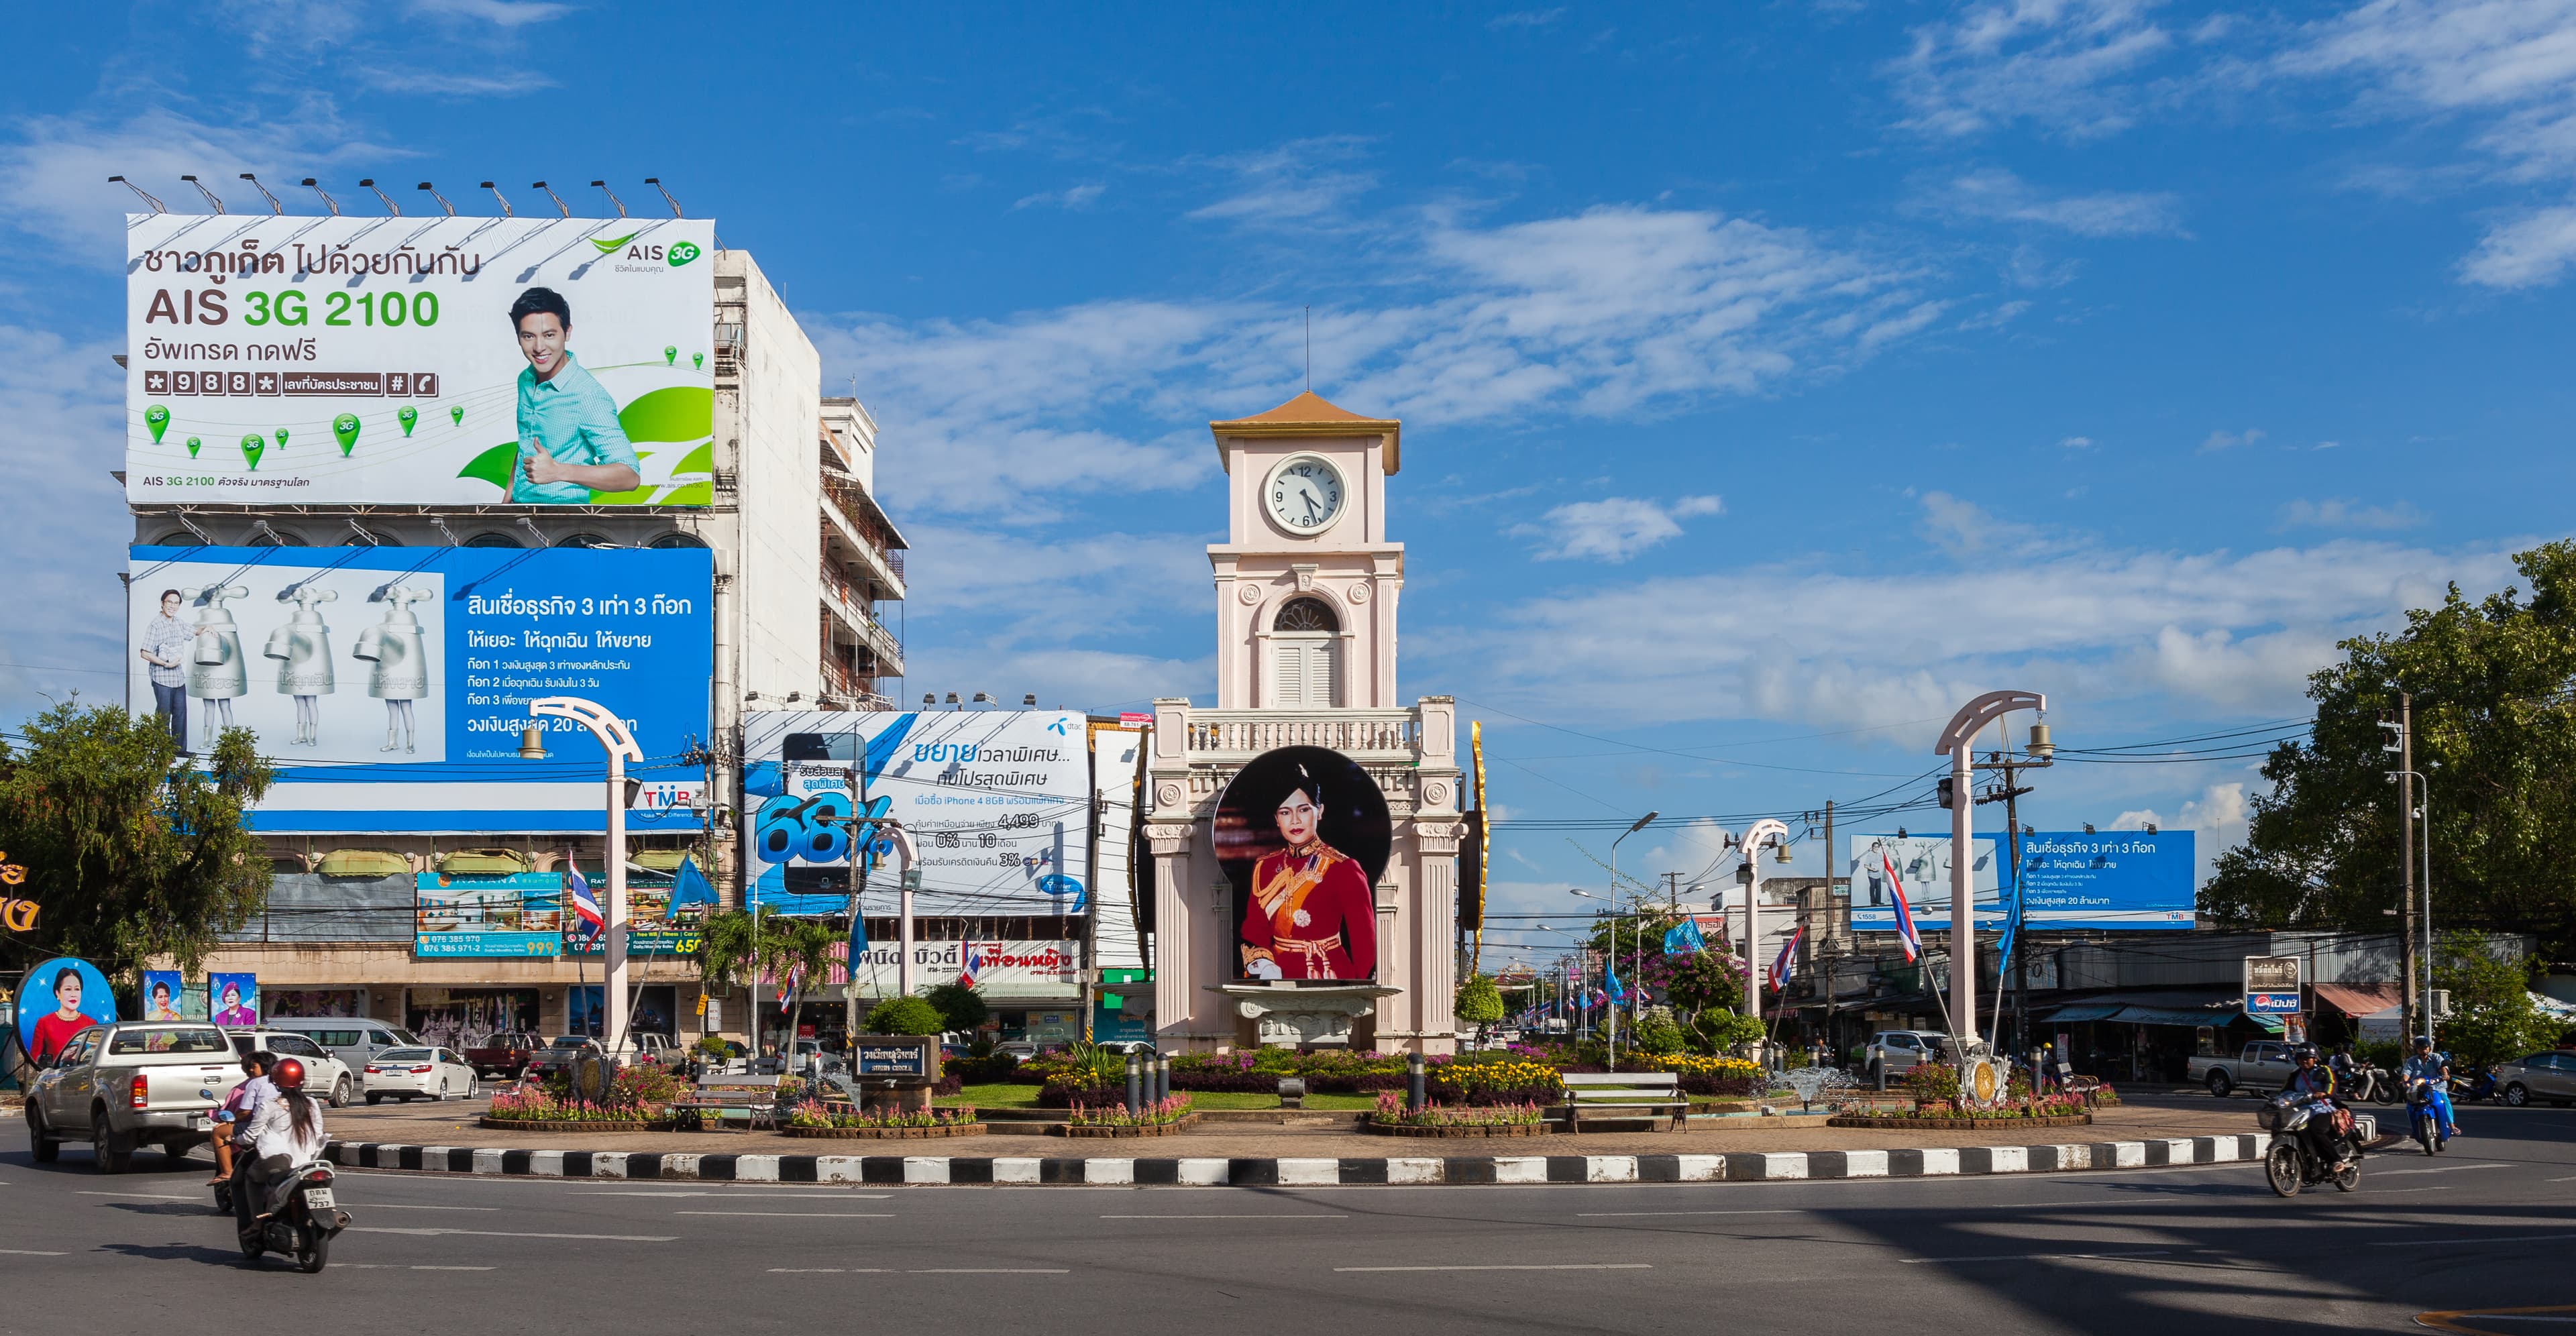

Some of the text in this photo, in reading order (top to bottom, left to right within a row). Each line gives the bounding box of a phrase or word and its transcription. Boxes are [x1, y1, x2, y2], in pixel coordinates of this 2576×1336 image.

[627, 245, 695, 261] AIS 3G
[144, 239, 480, 284] ชาวภูเก็ต ไปด้วยกันกับ
[146, 288, 439, 327] AIS 3G 2100
[144, 336, 317, 361] อัพเกรด กดฟรี
[284, 375, 379, 391] เลขที่บัตรประชาชน
[1298, 466, 1311, 478] 12
[143, 476, 310, 488] AIS 3G 2100 ตัวจริง มาตรฐานโลก
[1276, 491, 1337, 502] 9 3
[1303, 516, 1310, 526] 6
[468, 588, 692, 621] สินเชื่อธุรกิจ 3 เท่า 3 ก๊อก
[467, 630, 651, 653] ให้เยอะ ให้ฉุกเฉิน ให้ขยาย
[467, 657, 631, 673] ก๊อก 1 วงเงินสูงสุด 3 เท่าของหลักประกัน
[467, 675, 600, 690] ก๊อก 2 เมื่อฉุกเฉิน รับเงินใน 3 วัน
[467, 693, 490, 706] ก๊อก
[492, 695, 500, 705] 3
[553, 718, 573, 732] 20
[1067, 722, 1082, 730] dtac
[936, 768, 1047, 791] กับโปรสุดพิเศษ
[644, 785, 690, 806] TMB
[915, 793, 942, 805] เมื่อซื้อ
[944, 796, 975, 805] iPhone
[977, 796, 983, 805] 4
[985, 796, 1004, 805] 8GB
[998, 813, 1040, 831] 4,499
[935, 833, 960, 848] 0%
[978, 832, 996, 848] 10
[2026, 838, 2155, 857] สินเชื่อธุรกิจ 3 เท่า 3 ก๊อก
[999, 852, 1021, 867] 3%
[2026, 895, 2110, 907] วงเงินสูงสุด 20 ล้านบาท
[2166, 912, 2184, 920] TMB
[526, 942, 554, 955] 999
